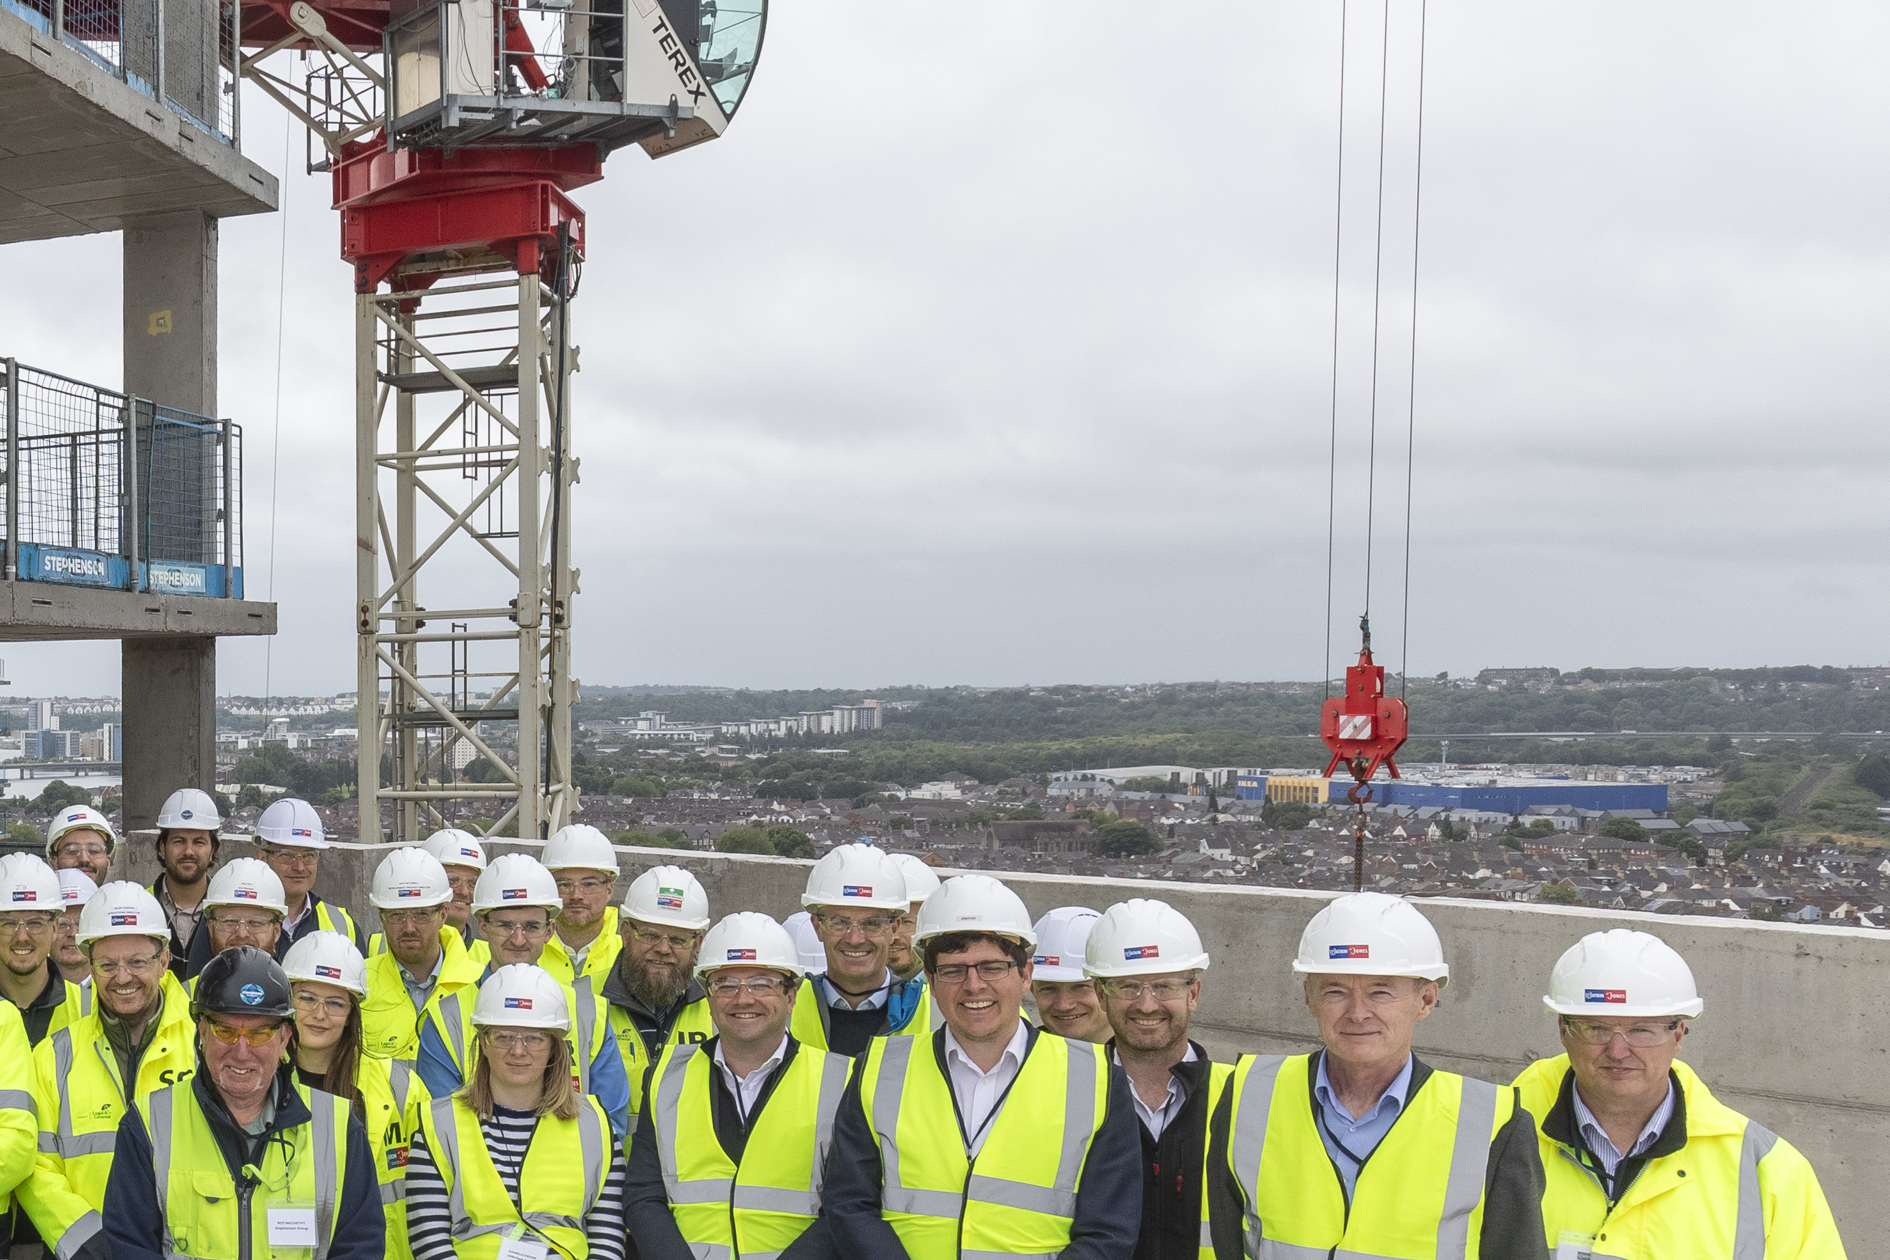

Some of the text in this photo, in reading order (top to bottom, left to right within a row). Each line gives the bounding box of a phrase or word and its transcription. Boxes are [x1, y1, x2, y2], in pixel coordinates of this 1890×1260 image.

[652, 15, 707, 106] TEREX
[44, 555, 105, 577] STEPHENSON
[149, 569, 202, 587] STEPHENSON
